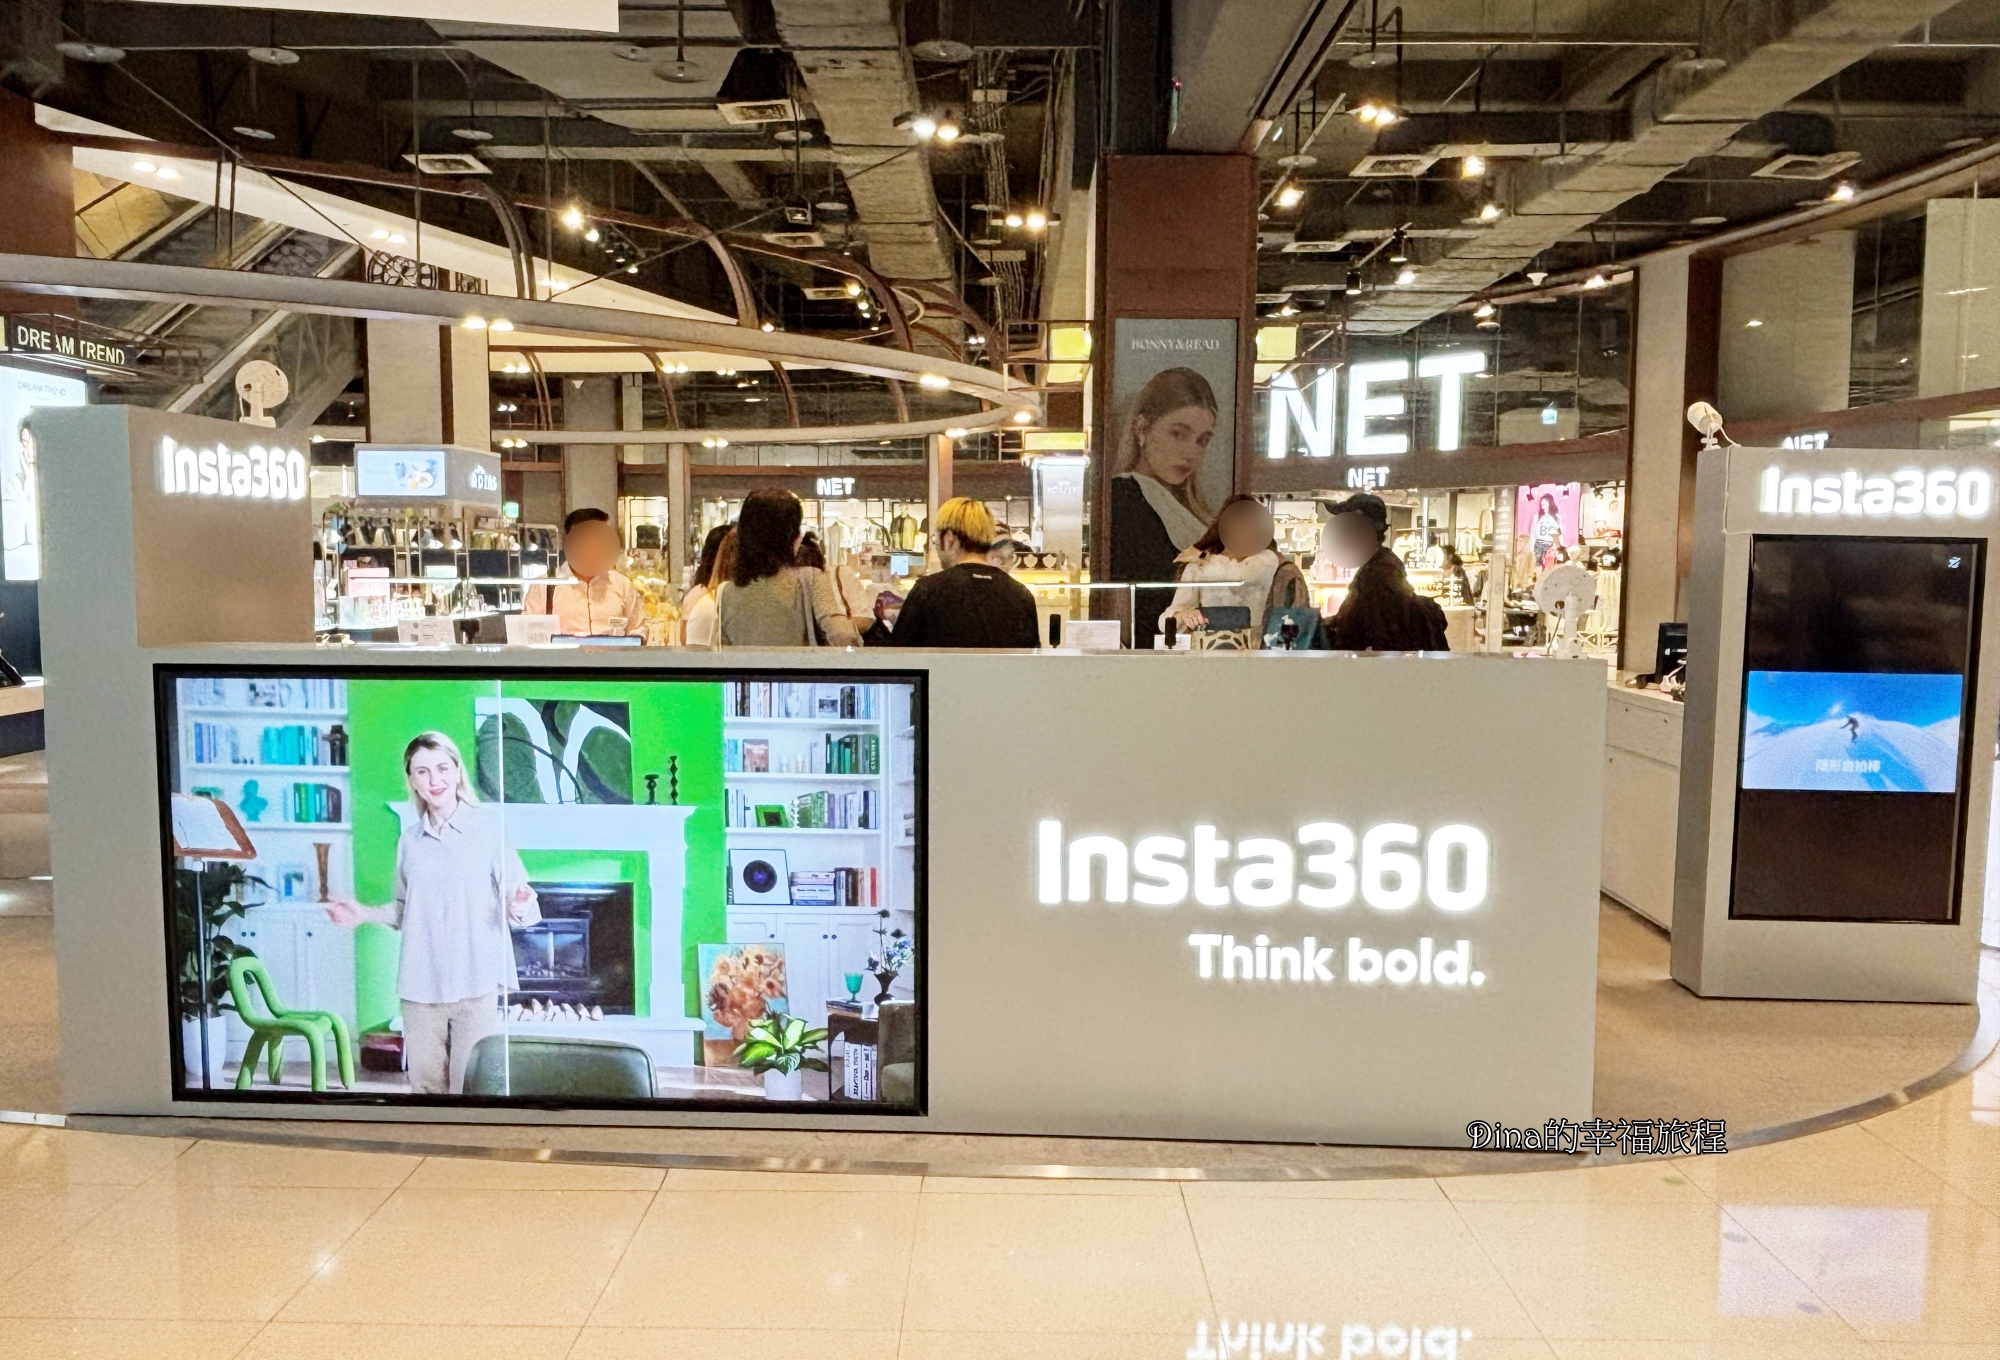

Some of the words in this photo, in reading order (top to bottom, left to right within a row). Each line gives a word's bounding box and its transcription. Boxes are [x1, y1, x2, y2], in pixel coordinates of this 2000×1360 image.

[80, 340, 125, 365] TREND
[1268, 352, 1485, 459] NET
[160, 435, 306, 500] Insta360
[816, 477, 856, 496] NET
[1347, 466, 1390, 487] NET
[1760, 466, 1991, 517] Insta360
[1038, 820, 1488, 911] Insta360
[1188, 933, 1334, 981] Think
[1348, 936, 1486, 986] bold.
